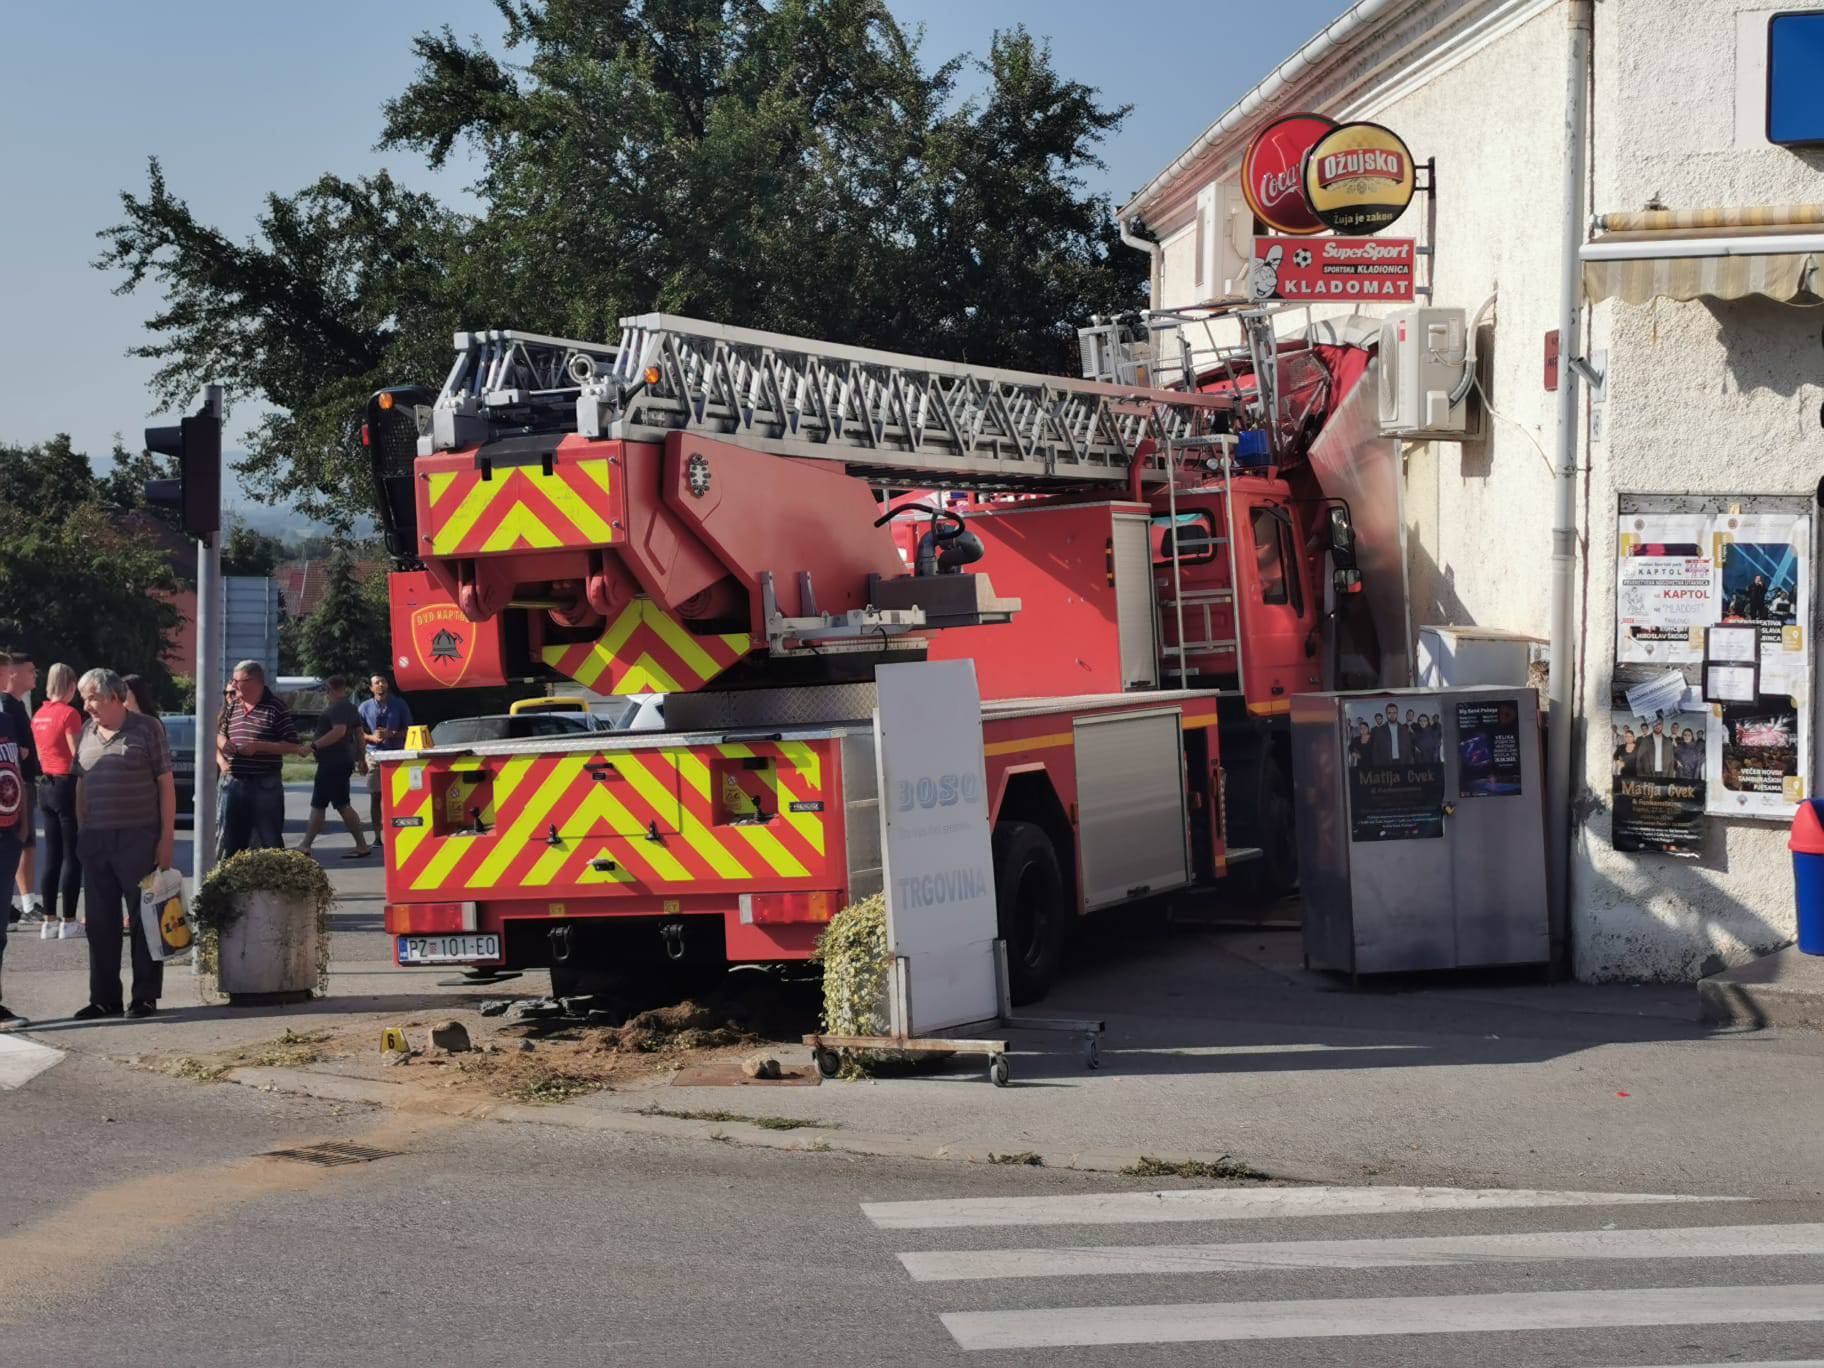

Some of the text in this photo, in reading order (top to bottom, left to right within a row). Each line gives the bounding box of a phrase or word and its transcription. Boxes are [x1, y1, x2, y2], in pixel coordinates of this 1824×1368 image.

[1325, 150, 1397, 179] Ožujsko
[1355, 213, 1365, 225] je
[1322, 242, 1409, 260] SuperSport
[1323, 264, 1408, 274] SPORTSKA KLADIONICA
[1284, 279, 1409, 294] KLADOMAT
[1638, 568, 1682, 576] KAPTOL
[1663, 589, 1710, 599] KAPTOL
[1360, 769, 1400, 786] Matija
[1622, 780, 1696, 799] Matija Cvek
[898, 866, 987, 911] TRGOVINA
[409, 940, 428, 958] PZ
[387, 1033, 395, 1050] 6
